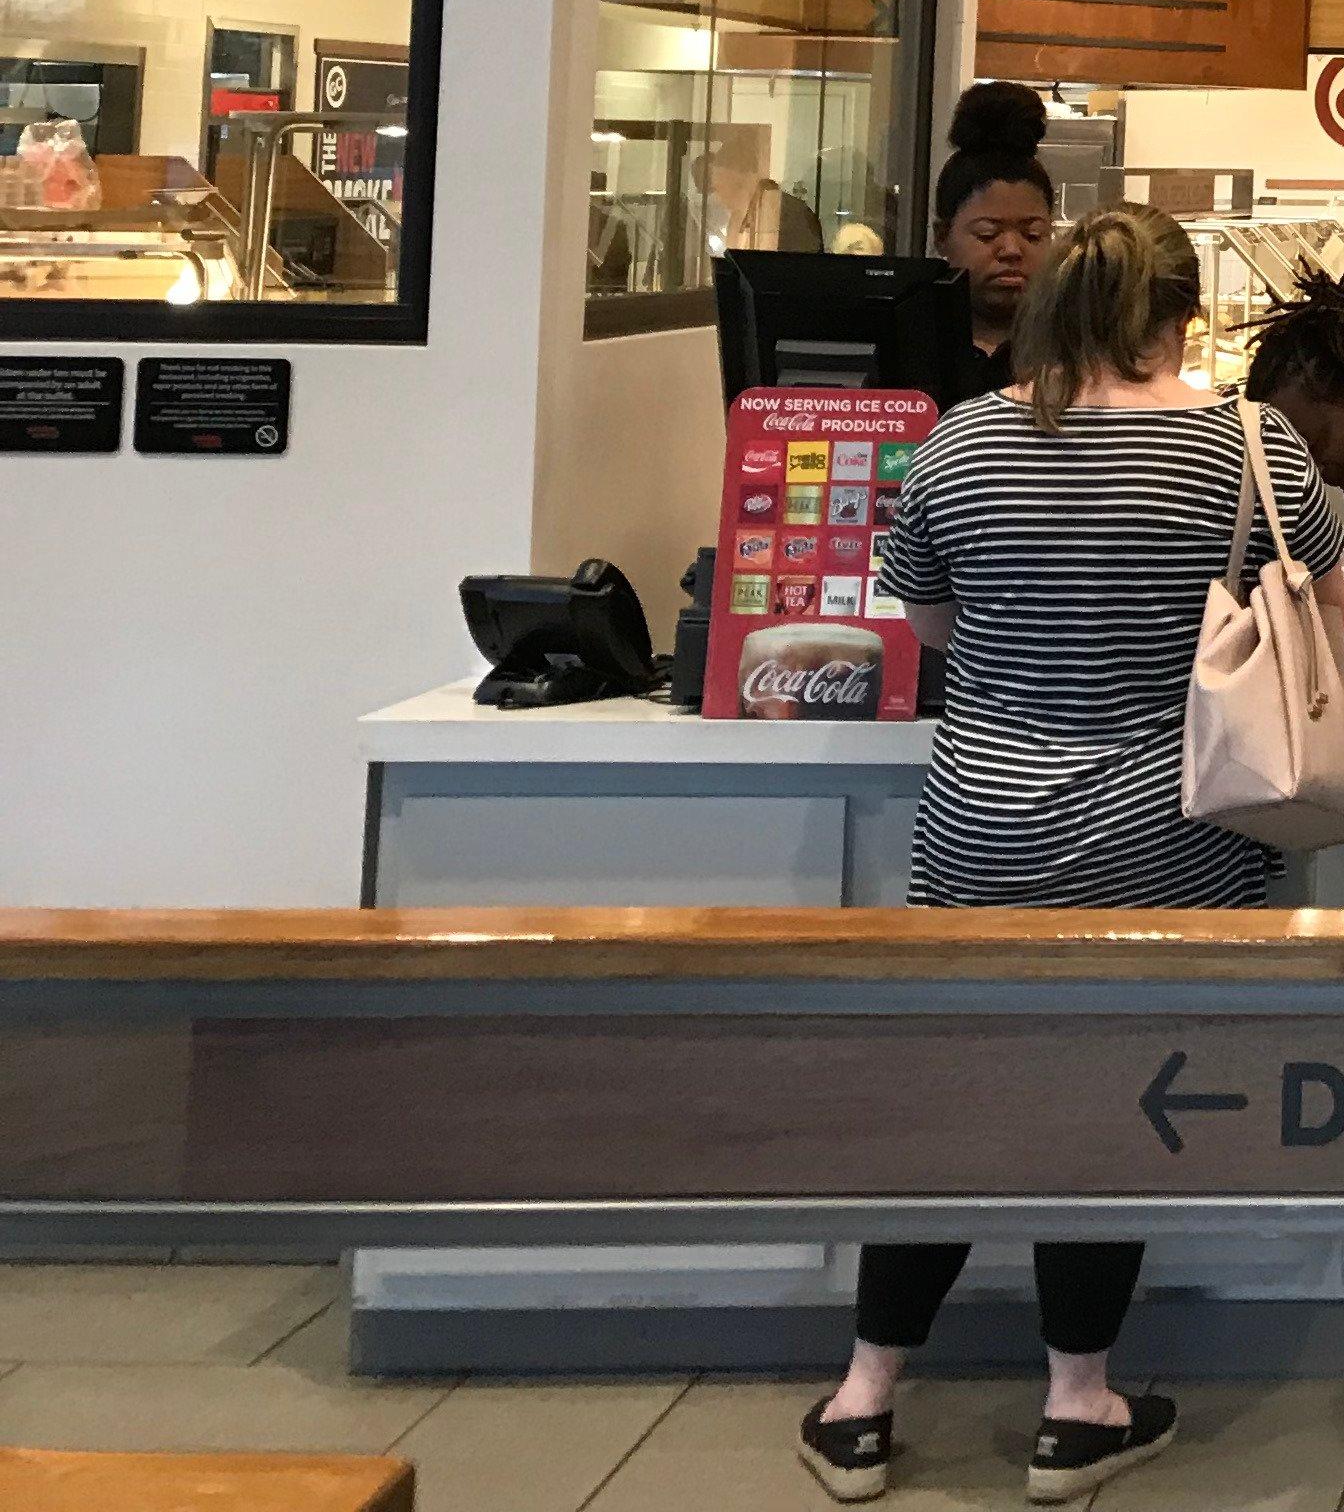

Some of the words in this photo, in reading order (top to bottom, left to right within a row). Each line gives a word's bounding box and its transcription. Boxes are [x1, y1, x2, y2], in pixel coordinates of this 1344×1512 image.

[322, 132, 337, 175] THE
[740, 397, 781, 411] NOW
[784, 398, 851, 412] SERVING
[855, 399, 880, 413] ICE
[884, 400, 927, 414] COLD
[762, 413, 817, 432] Coca-Cola
[821, 420, 905, 434] PRODUCTS
[785, 585, 807, 597] HOT
[785, 596, 806, 607] TEA
[827, 595, 854, 606] MILK
[743, 660, 876, 704] Coca-Cola
